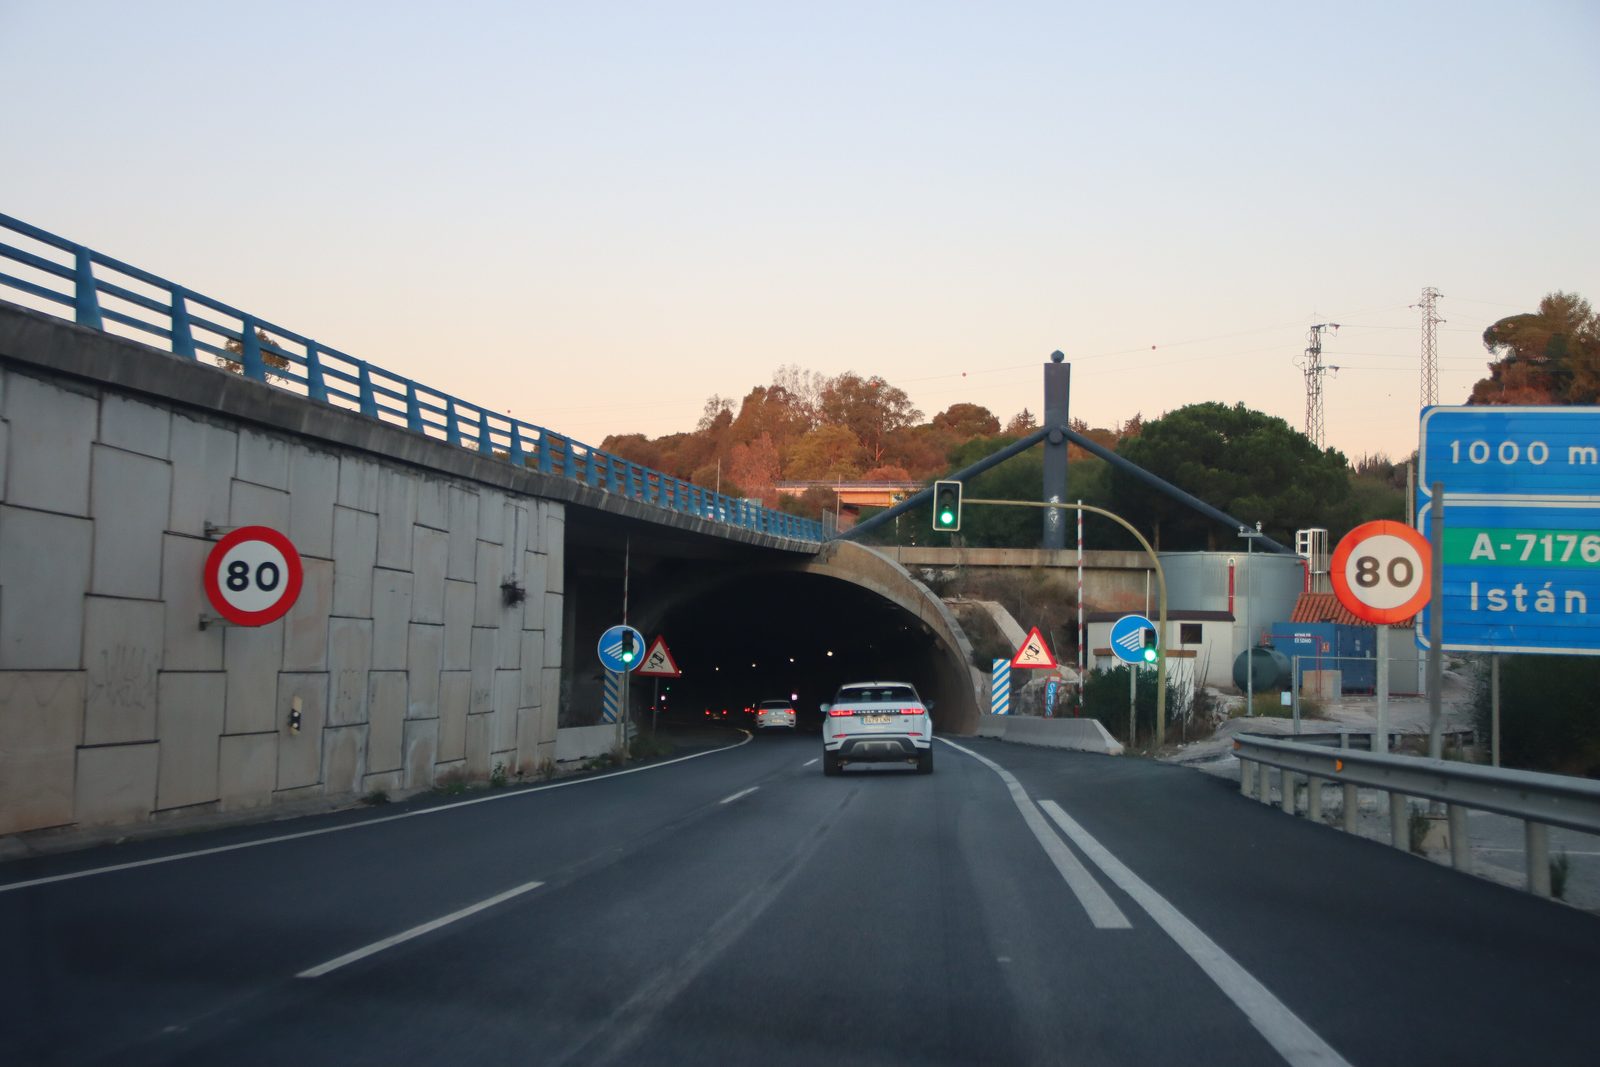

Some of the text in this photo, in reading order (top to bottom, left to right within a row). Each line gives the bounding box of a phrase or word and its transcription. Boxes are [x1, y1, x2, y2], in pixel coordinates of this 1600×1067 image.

[1450, 440, 1598, 465] 1000 m
[1469, 533, 1600, 563] A-7176
[226, 560, 280, 592] 80
[1355, 556, 1414, 588] 80
[1470, 582, 1587, 614] Istán
